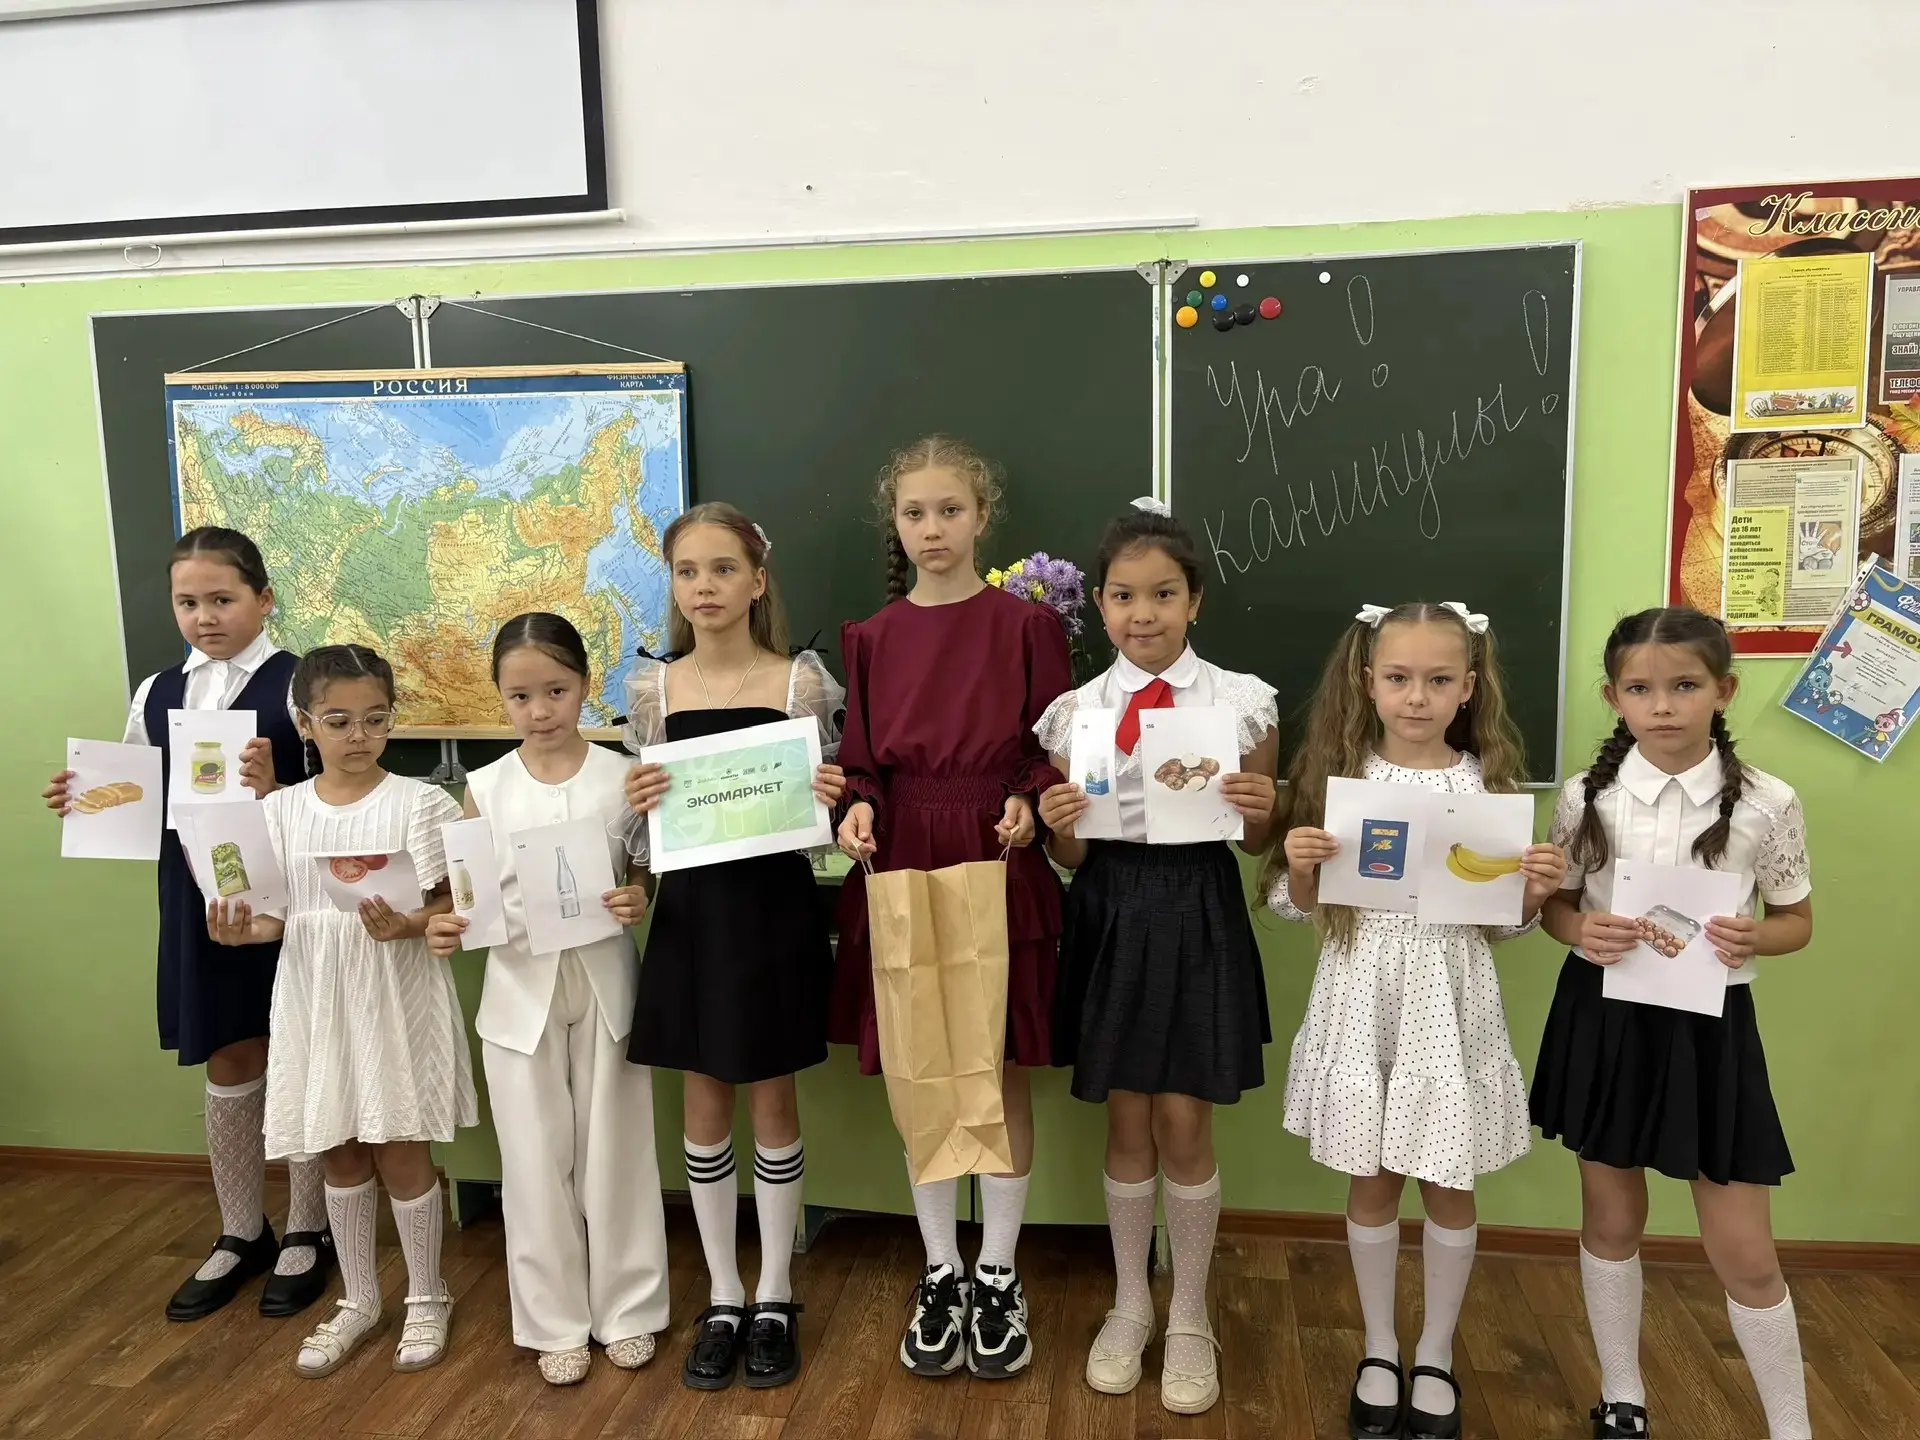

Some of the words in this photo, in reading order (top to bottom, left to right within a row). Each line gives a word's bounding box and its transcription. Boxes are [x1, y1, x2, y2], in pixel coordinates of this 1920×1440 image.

[1748, 191, 1920, 236] Классн
[1892, 343, 1918, 355] ЗНАЙ!
[192, 383, 228, 391] МАСШТАБ
[373, 378, 468, 395] РОССИЯ
[620, 380, 644, 388] КАРТА
[1731, 515, 1753, 525] Дети
[686, 780, 784, 809] ЭКОМАРКЕТ
